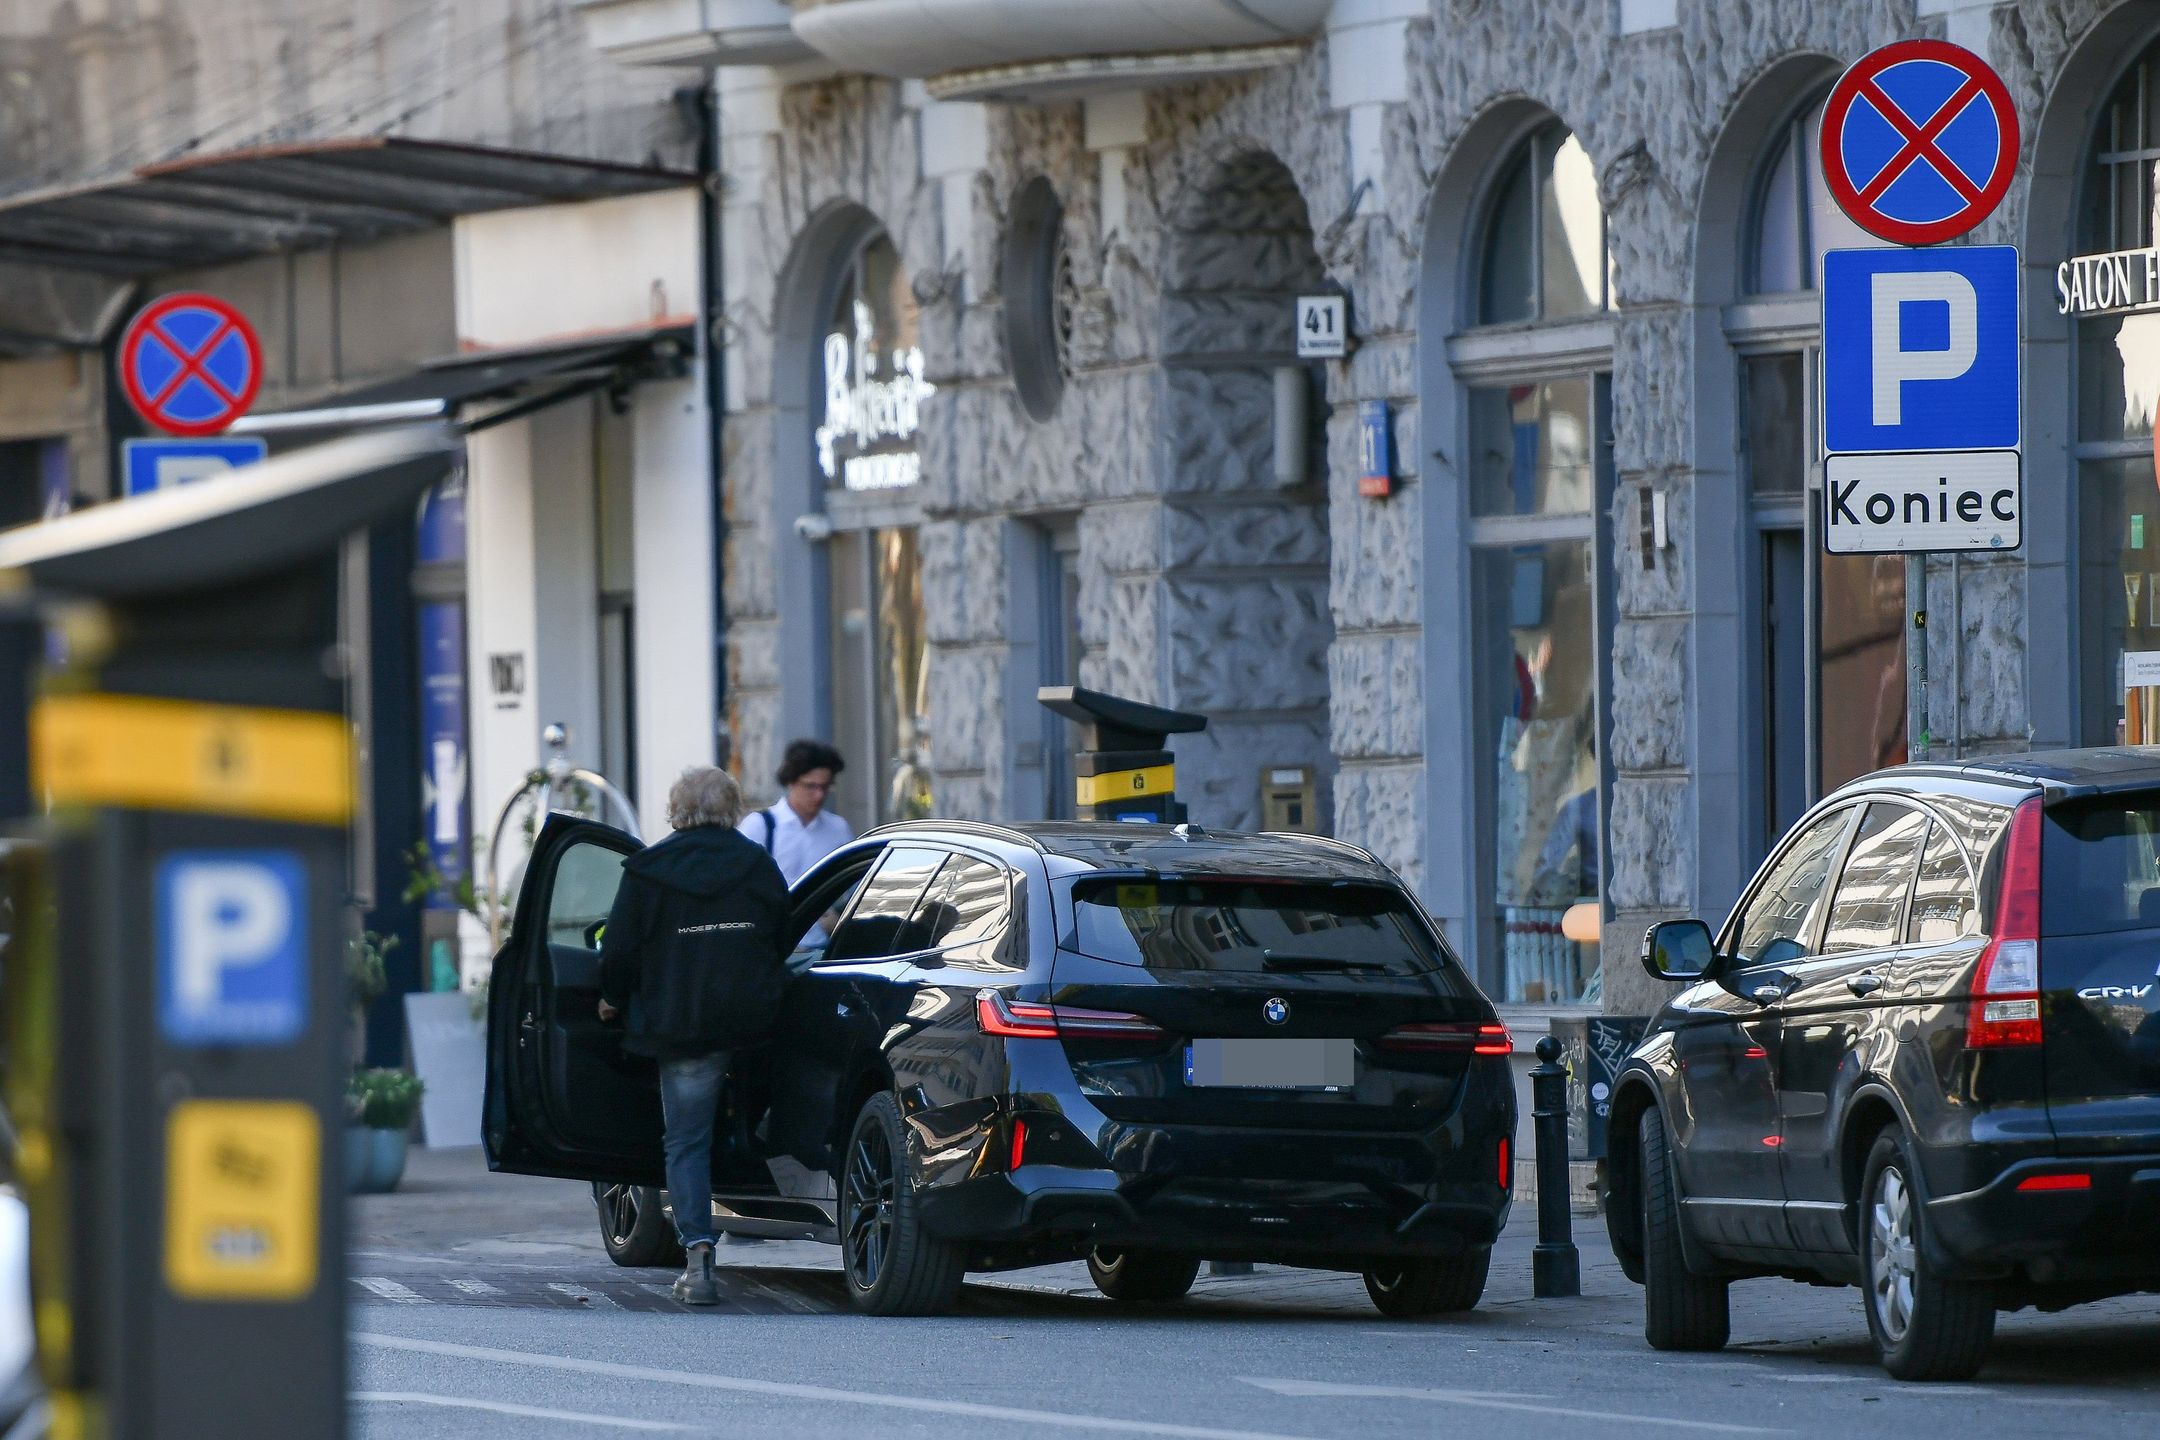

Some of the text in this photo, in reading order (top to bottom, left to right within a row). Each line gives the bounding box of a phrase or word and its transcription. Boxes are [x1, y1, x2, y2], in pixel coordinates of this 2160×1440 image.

[2057, 251, 2160, 315] SALON F
[1304, 306, 1333, 333] 41
[1871, 271, 1977, 426] P
[1830, 477, 2015, 526] Koniec
[169, 860, 291, 1013] P
[679, 925, 704, 933] MADE
[2077, 984, 2153, 1000] CR-V
